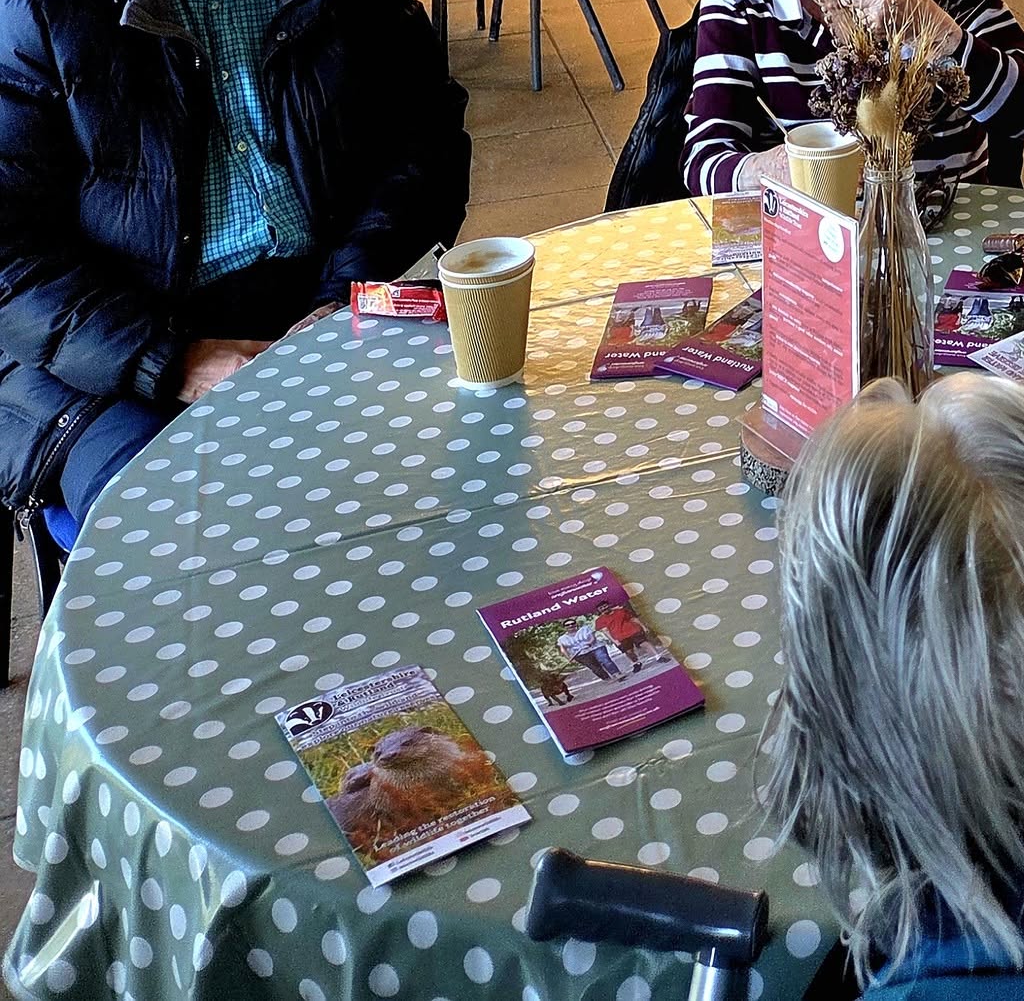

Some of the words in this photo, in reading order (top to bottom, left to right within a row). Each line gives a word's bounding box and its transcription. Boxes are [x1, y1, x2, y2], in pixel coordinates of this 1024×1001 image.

[682, 346, 713, 362] Water
[934, 338, 964, 348] Wate
[604, 350, 641, 360] Water
[714, 356, 755, 372] Rutland
[500, 602, 561, 629] Rutland
[562, 586, 609, 606] Water
[333, 670, 416, 702] Leicestershire
[346, 680, 394, 703] Rutland
[374, 828, 418, 853] Leading
[418, 820, 437, 832] the
[438, 796, 496, 823] restoration
[402, 825, 445, 847] wildlife
[445, 806, 490, 829] together
